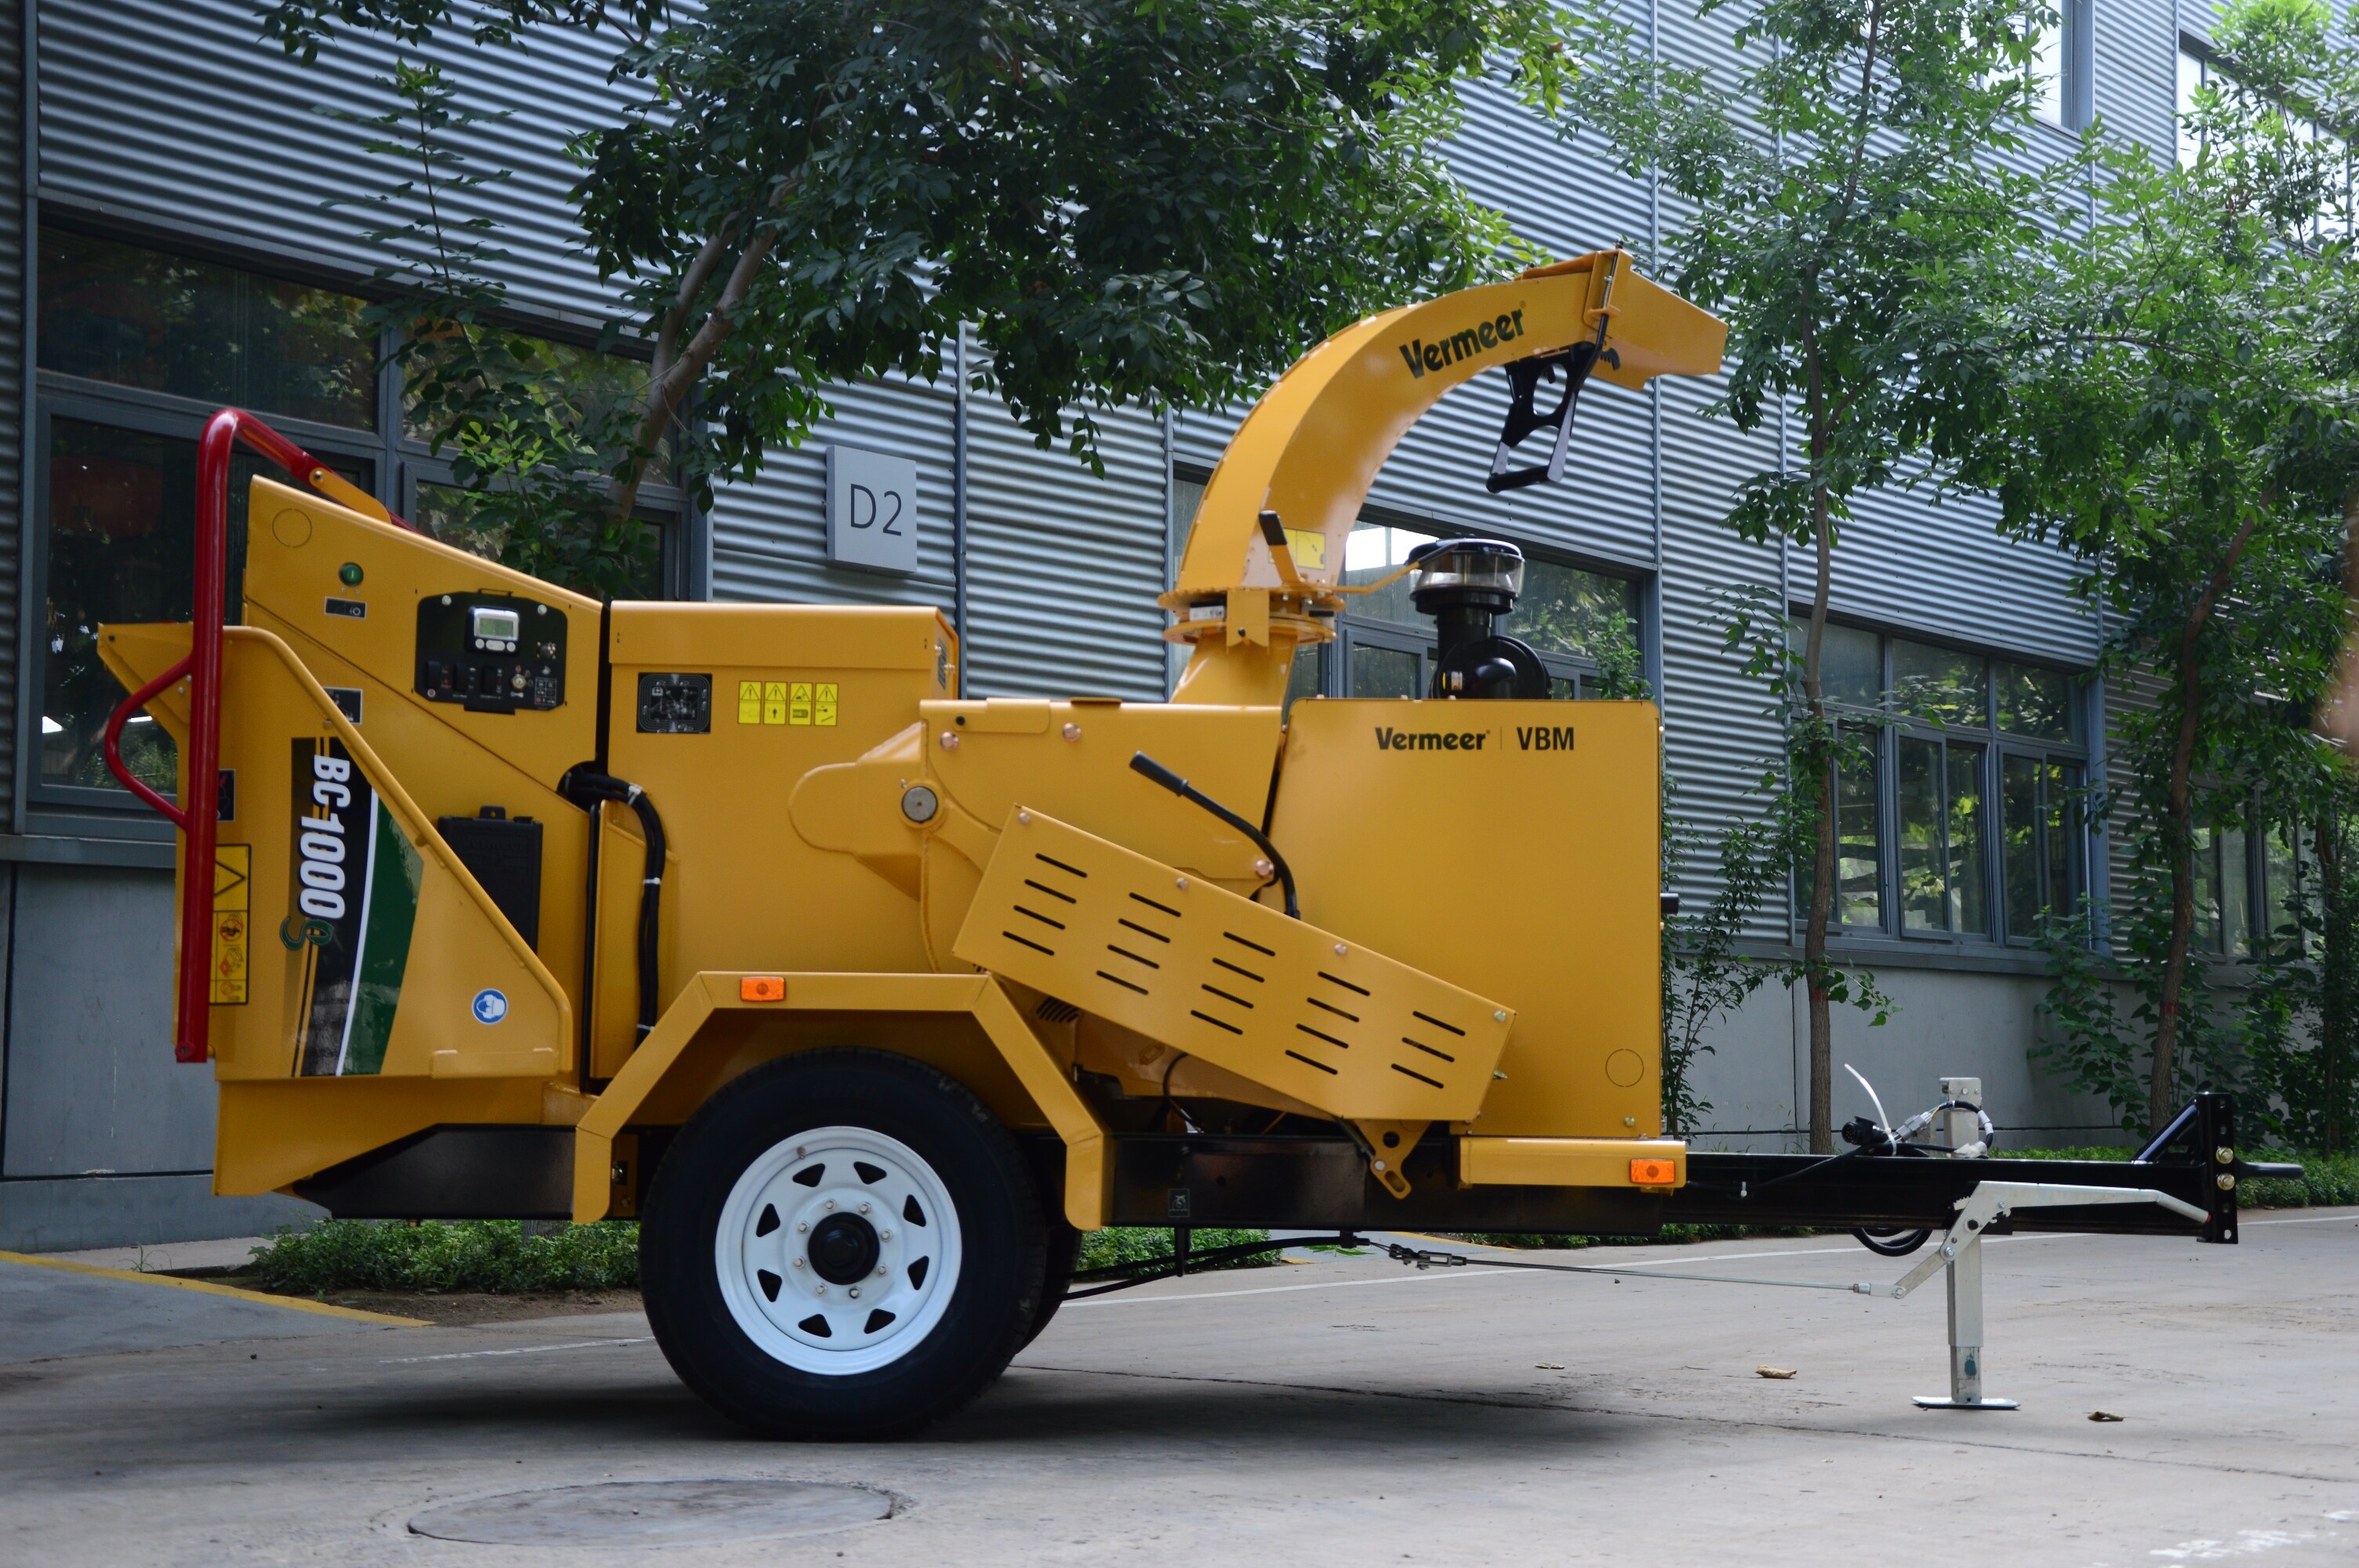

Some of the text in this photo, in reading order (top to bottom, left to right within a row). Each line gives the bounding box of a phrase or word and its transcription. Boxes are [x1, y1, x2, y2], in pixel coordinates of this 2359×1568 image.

[1399, 309, 1524, 379] Vermeer
[850, 483, 901, 536] D2
[1376, 727, 1574, 750] Vermeer VBM
